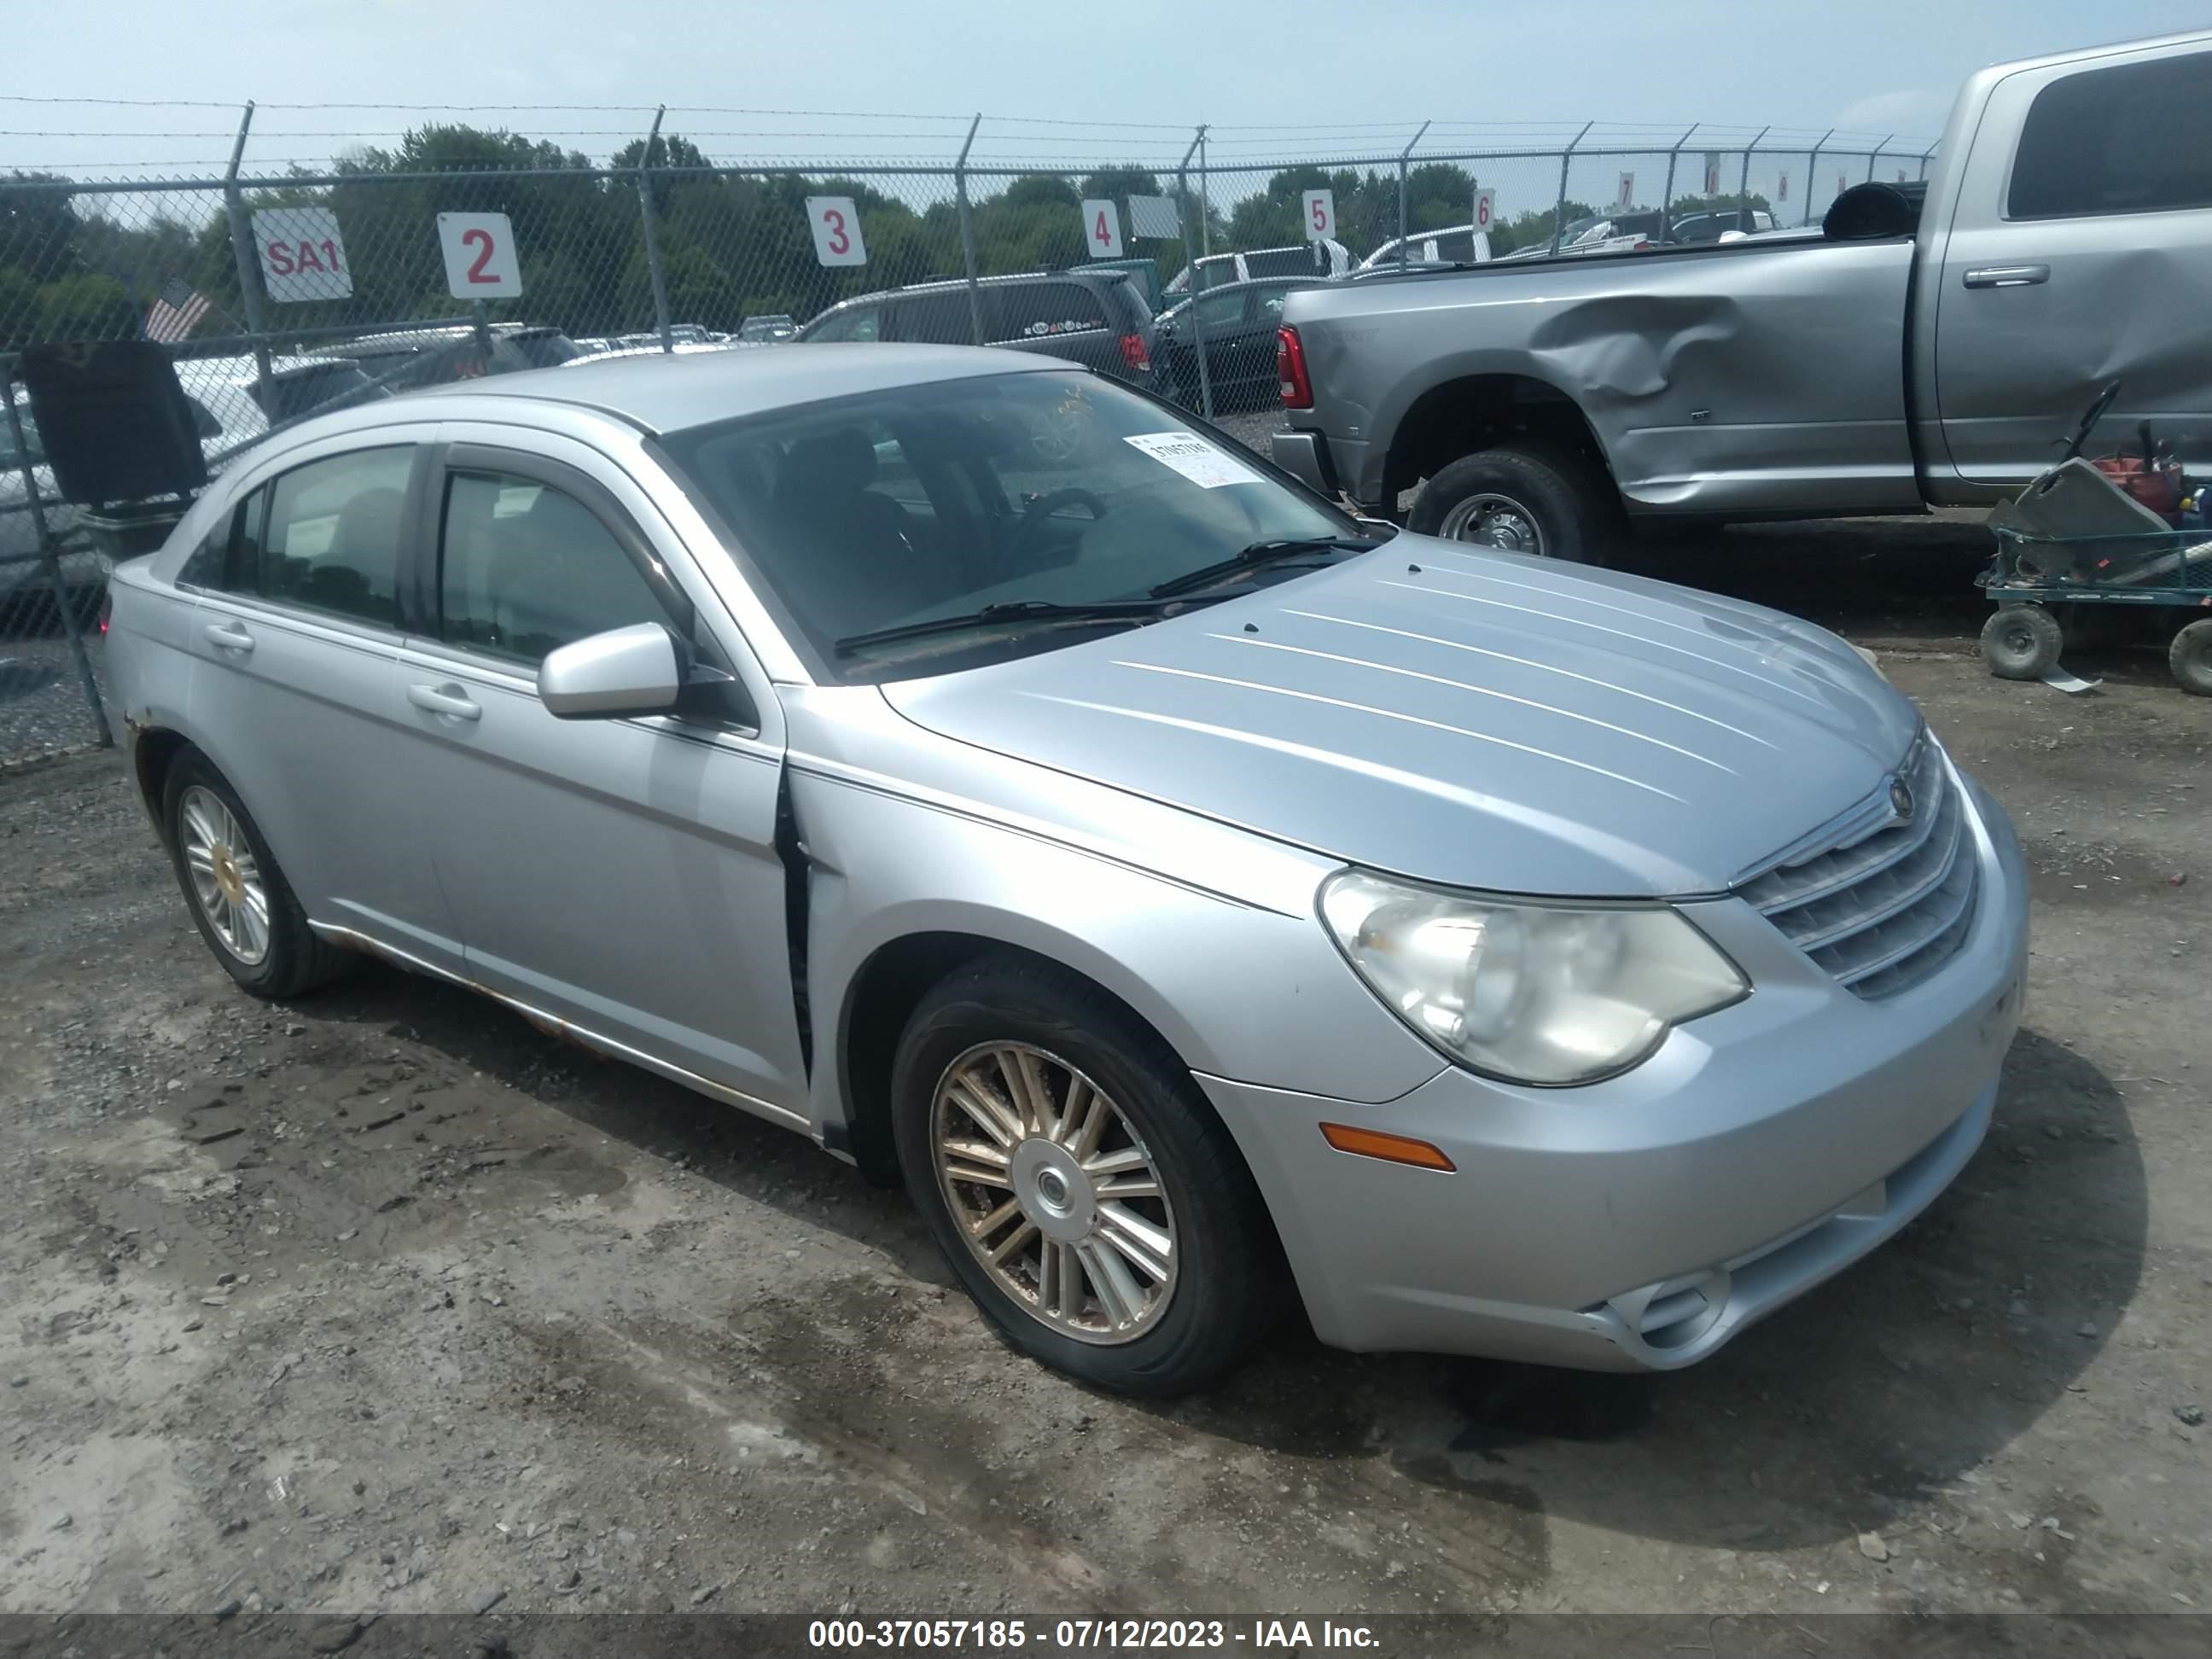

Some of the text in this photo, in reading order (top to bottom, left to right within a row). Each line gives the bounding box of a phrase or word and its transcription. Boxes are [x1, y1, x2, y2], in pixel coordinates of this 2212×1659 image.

[1622, 179, 1631, 199] 7
[1094, 210, 1112, 247] 4
[1311, 199, 1327, 232] 5
[1477, 195, 1490, 226] 6
[823, 208, 851, 255] 3
[266, 239, 340, 276] SA1
[462, 228, 502, 284] 2
